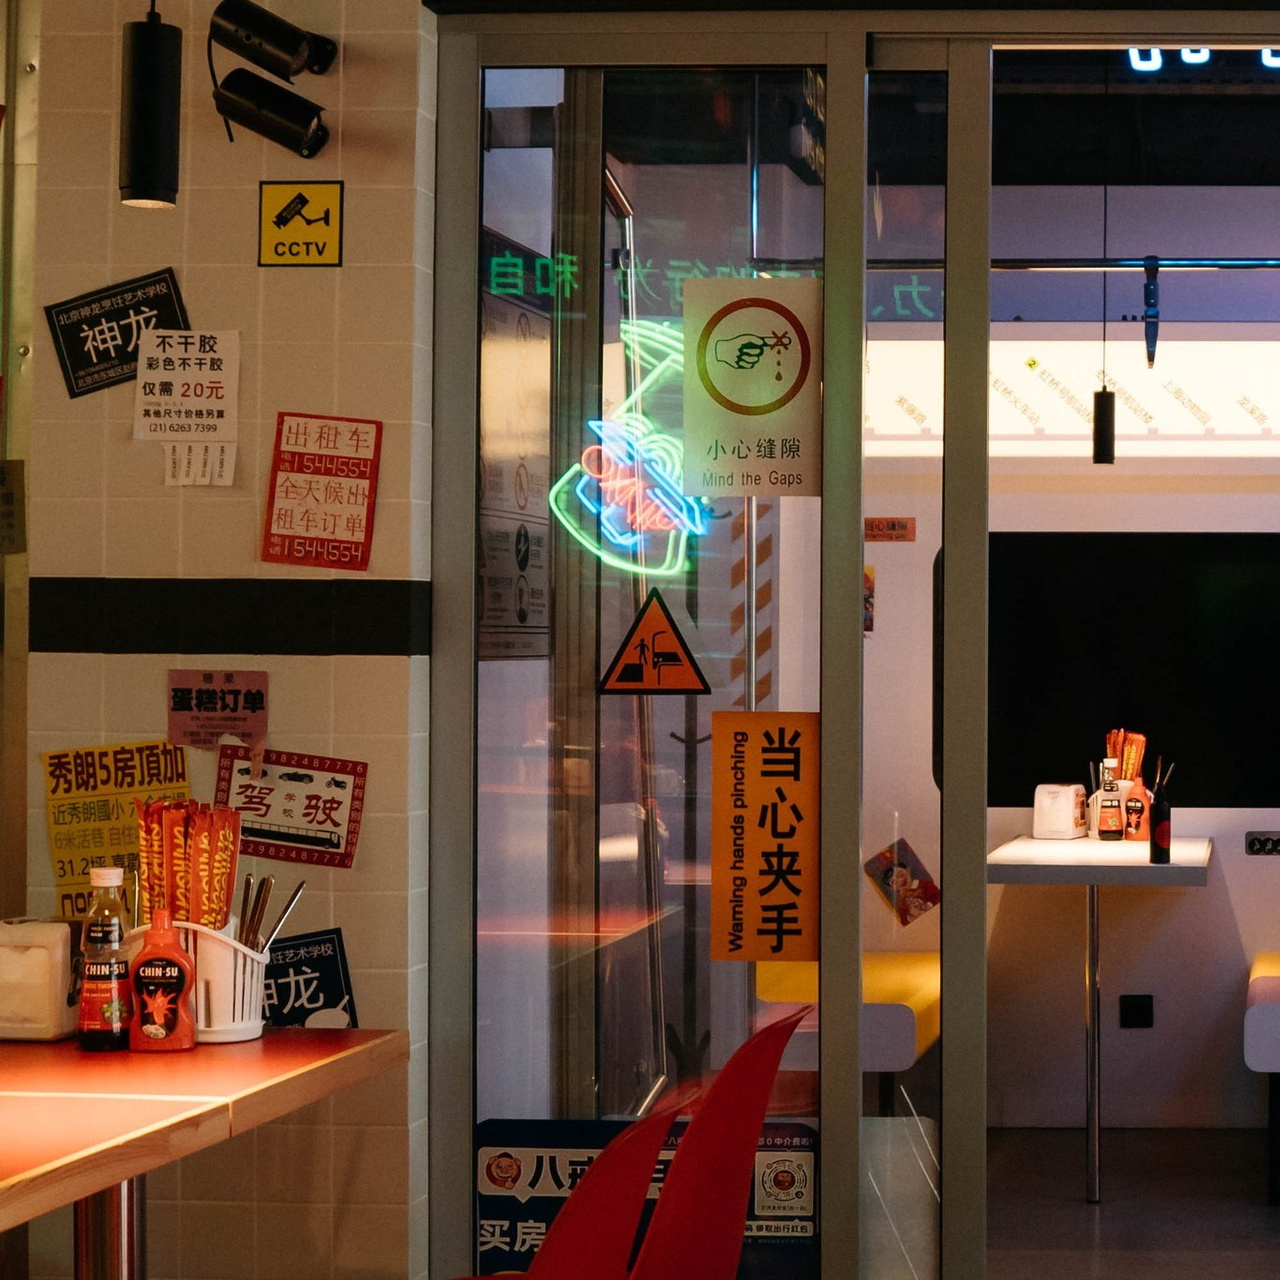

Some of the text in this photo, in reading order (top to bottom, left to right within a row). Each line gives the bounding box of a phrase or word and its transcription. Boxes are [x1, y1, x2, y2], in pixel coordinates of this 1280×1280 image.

[274, 241, 327, 257] CCTV
[156, 334, 218, 354] 不干胶
[145, 357, 224, 371] 彩色不干胶
[142, 380, 225, 400] 仅需 20元
[143, 409, 225, 419] 其他尺寸价格另算
[149, 423, 218, 433] (21) 6263 7399
[286, 422, 370, 453] 出租车
[707, 437, 801, 460] 小心缝隙
[294, 454, 370, 477] 1544554
[703, 470, 803, 488] Mind the Gaps
[277, 476, 368, 507] 全天候出
[274, 507, 364, 537] 租车订单
[171, 687, 266, 714] 蛋糕订单
[48, 742, 187, 796] 秀朗5房頂加
[728, 730, 749, 953] Warning hands pinching
[756, 727, 804, 954] 当心夹手
[139, 966, 179, 977] CHIN-SU
[479, 1220, 548, 1254] 买房
